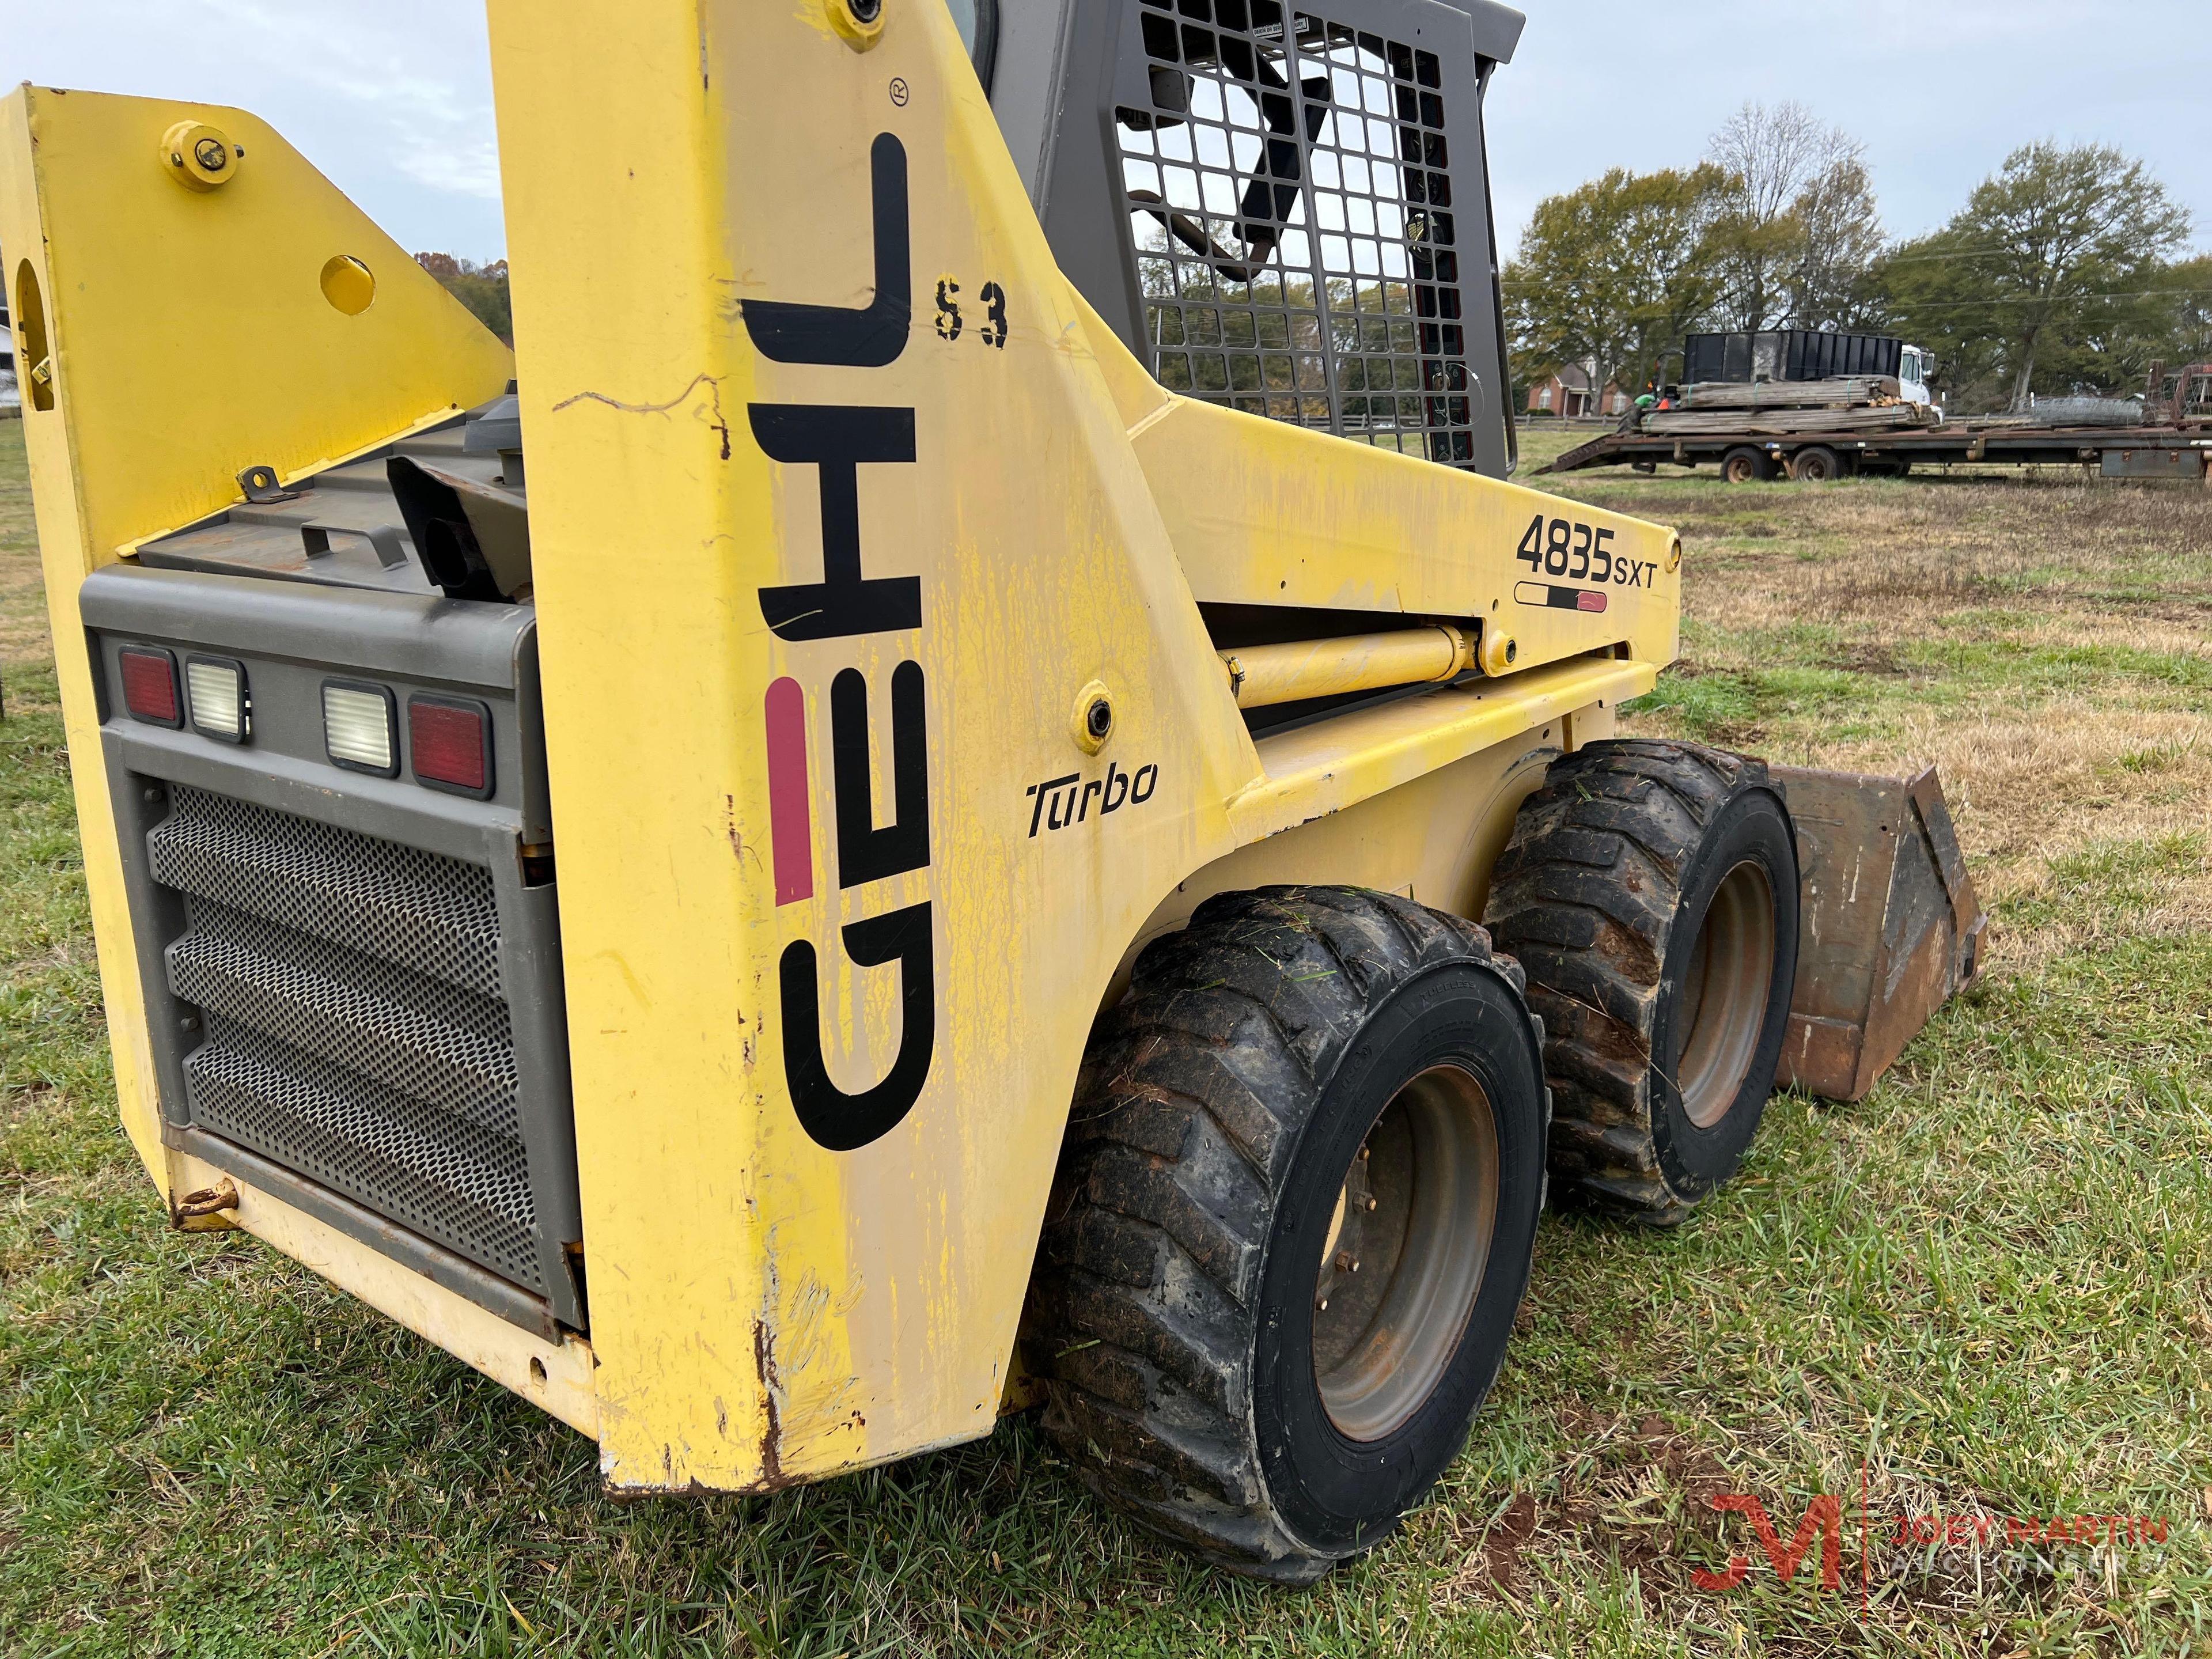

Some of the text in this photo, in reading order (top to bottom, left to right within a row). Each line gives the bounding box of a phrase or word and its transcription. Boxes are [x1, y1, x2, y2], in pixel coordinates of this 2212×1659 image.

[1516, 514, 1657, 589] 4835 SXT
[741, 132, 934, 1152] GEHL
[1026, 762, 1158, 838] Turbo
